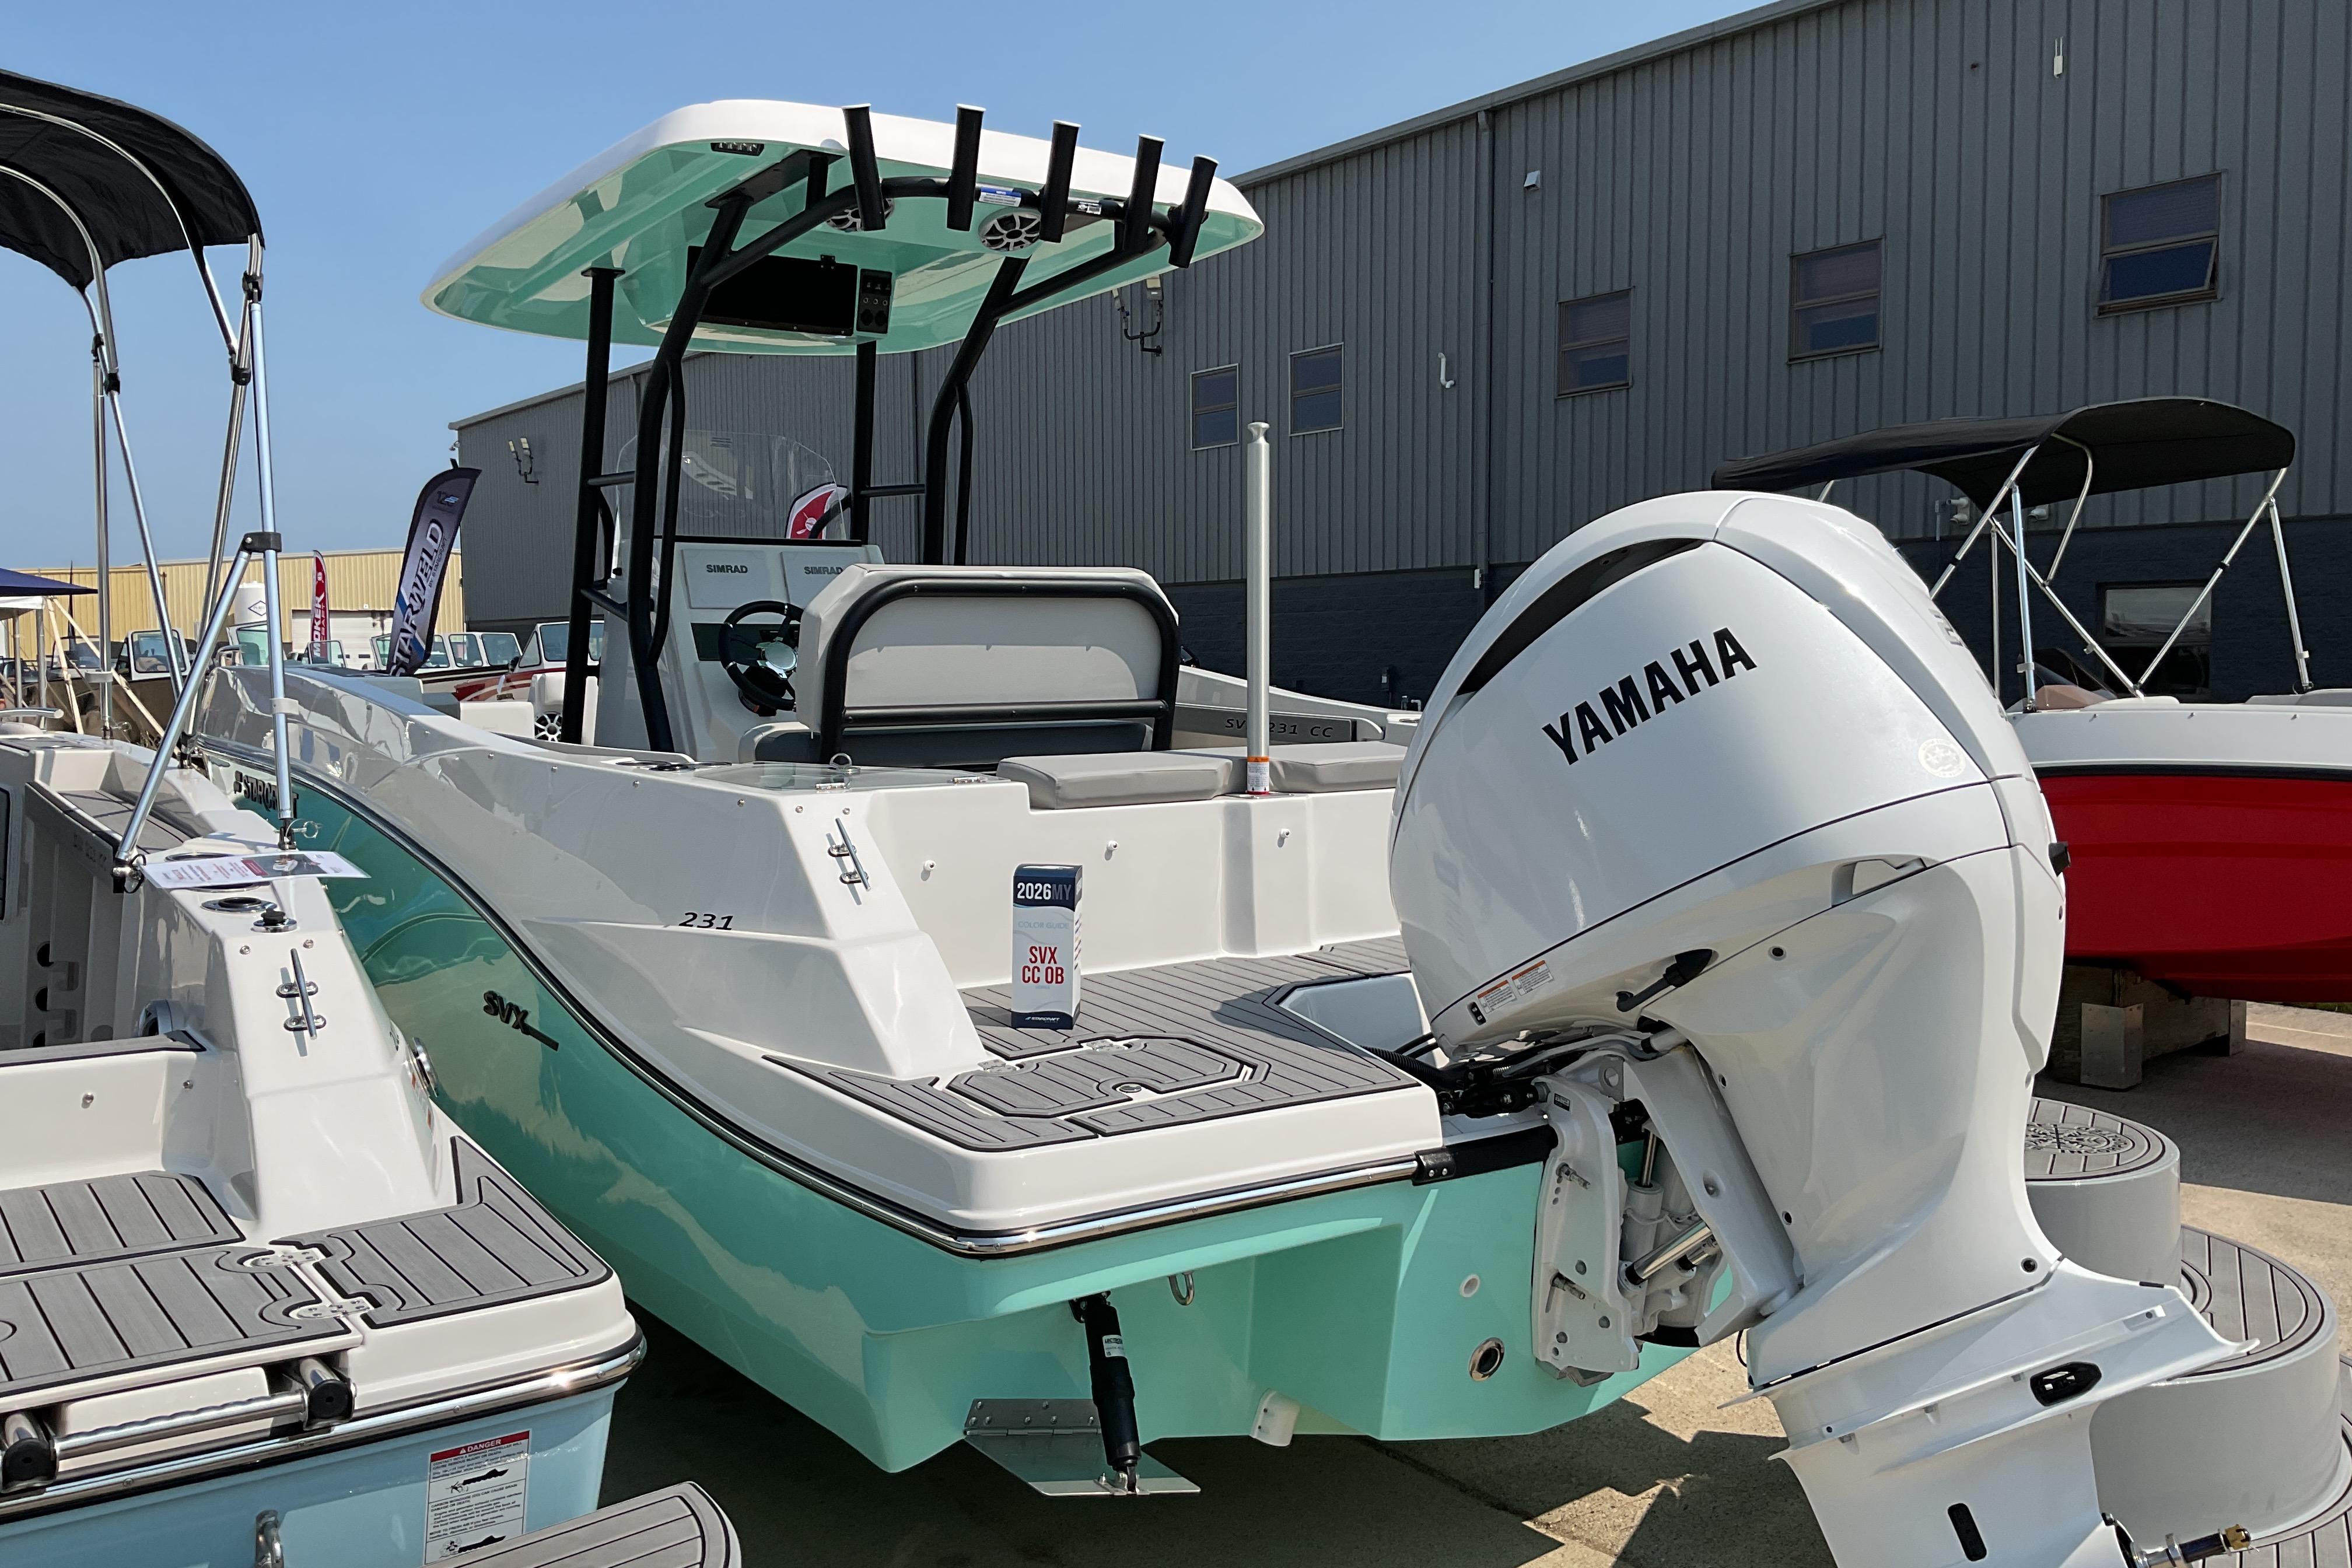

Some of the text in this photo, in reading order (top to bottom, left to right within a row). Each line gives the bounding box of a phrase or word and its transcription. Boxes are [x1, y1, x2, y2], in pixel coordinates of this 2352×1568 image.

[706, 564, 748, 573] SIMRAD
[804, 566, 844, 575] SIMRAD
[313, 592, 325, 657] MOKER
[1542, 627, 1757, 766] YAMAHA
[1225, 718, 1334, 738] SV 231 CC
[243, 774, 299, 819] STARCRT
[1017, 882, 1072, 900] 2026MY
[678, 912, 733, 930] 231
[1029, 946, 1058, 964] SVX
[1022, 965, 1065, 985] CC OB
[467, 1438, 502, 1452] DANGER
